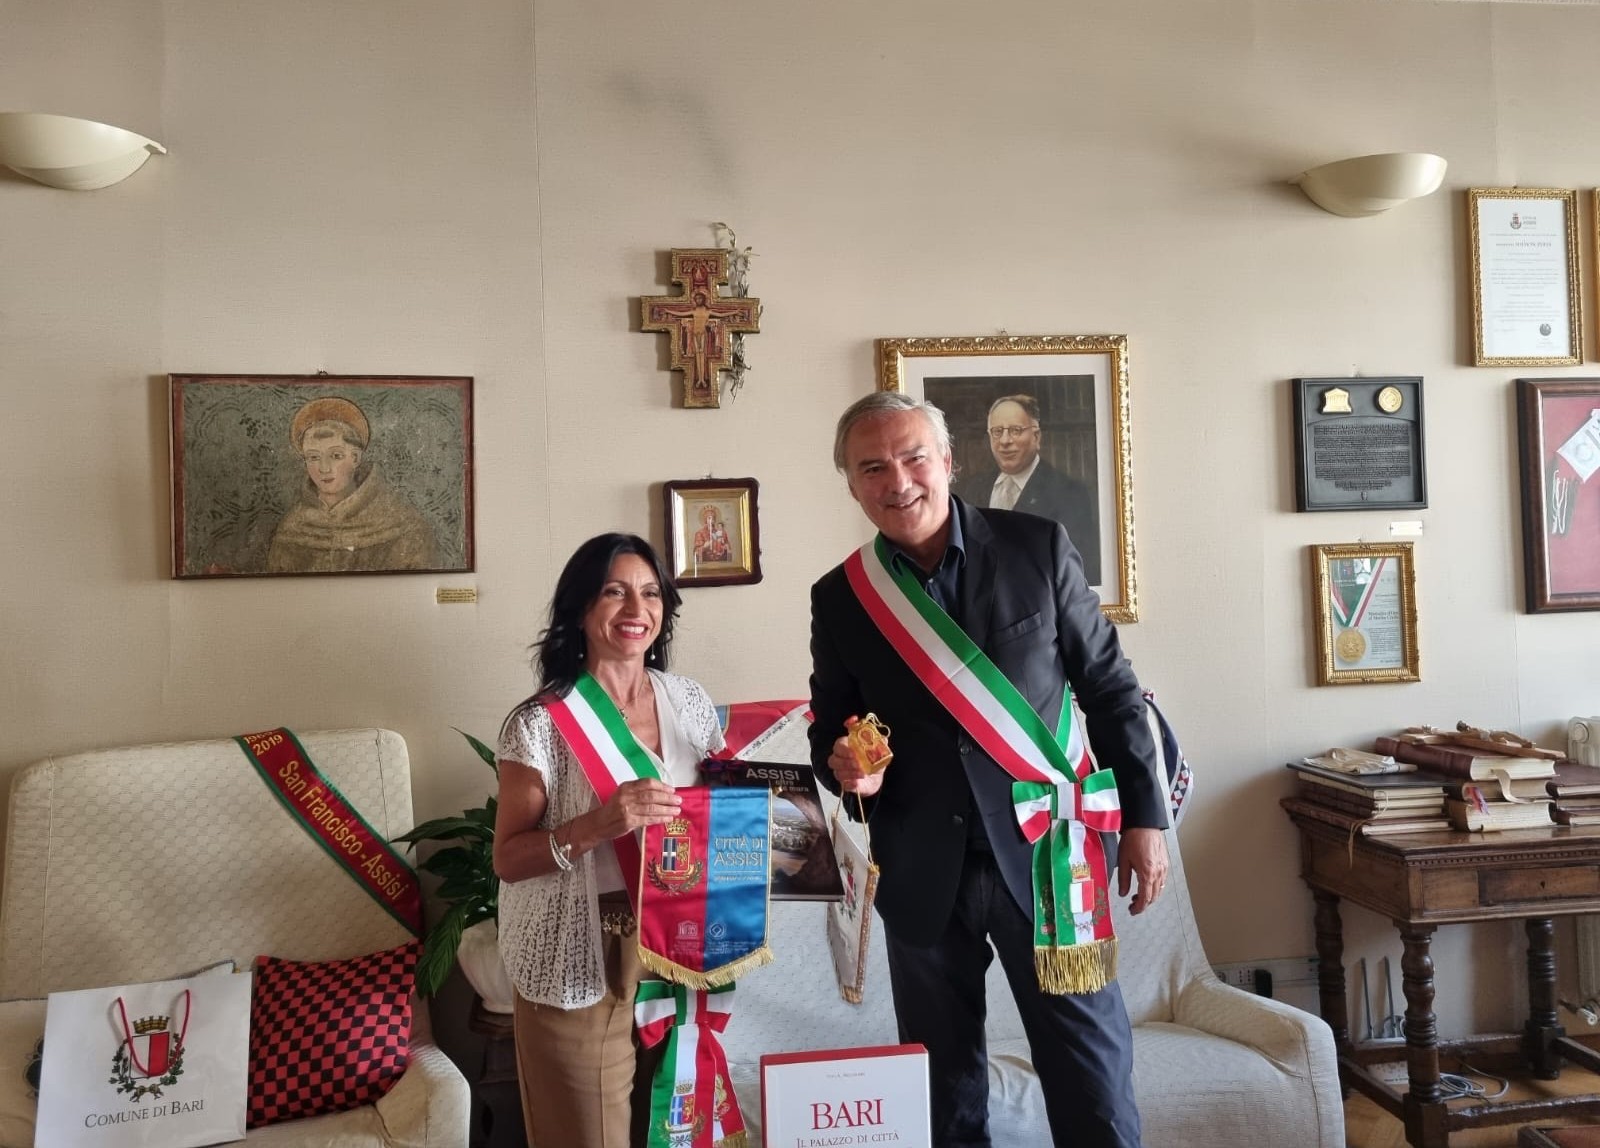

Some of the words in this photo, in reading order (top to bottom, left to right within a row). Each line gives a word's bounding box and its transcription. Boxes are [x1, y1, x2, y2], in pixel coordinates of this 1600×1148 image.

[252, 734, 283, 756] 2019
[746, 768, 800, 780] ASSISI
[278, 760, 307, 796] San
[299, 786, 363, 855] Francisco
[715, 835, 748, 849] CITTÀ
[751, 837, 763, 849] DI
[713, 851, 763, 867] ASSISI
[84, 1108, 149, 1128] COMUNE
[152, 1105, 167, 1118] DI
[170, 1099, 204, 1115] BARI
[810, 1098, 885, 1130] BARI
[810, 1136, 853, 1148] PALAZZO
[857, 1134, 868, 1144] DI
[871, 1130, 900, 1142] CITTÀ
